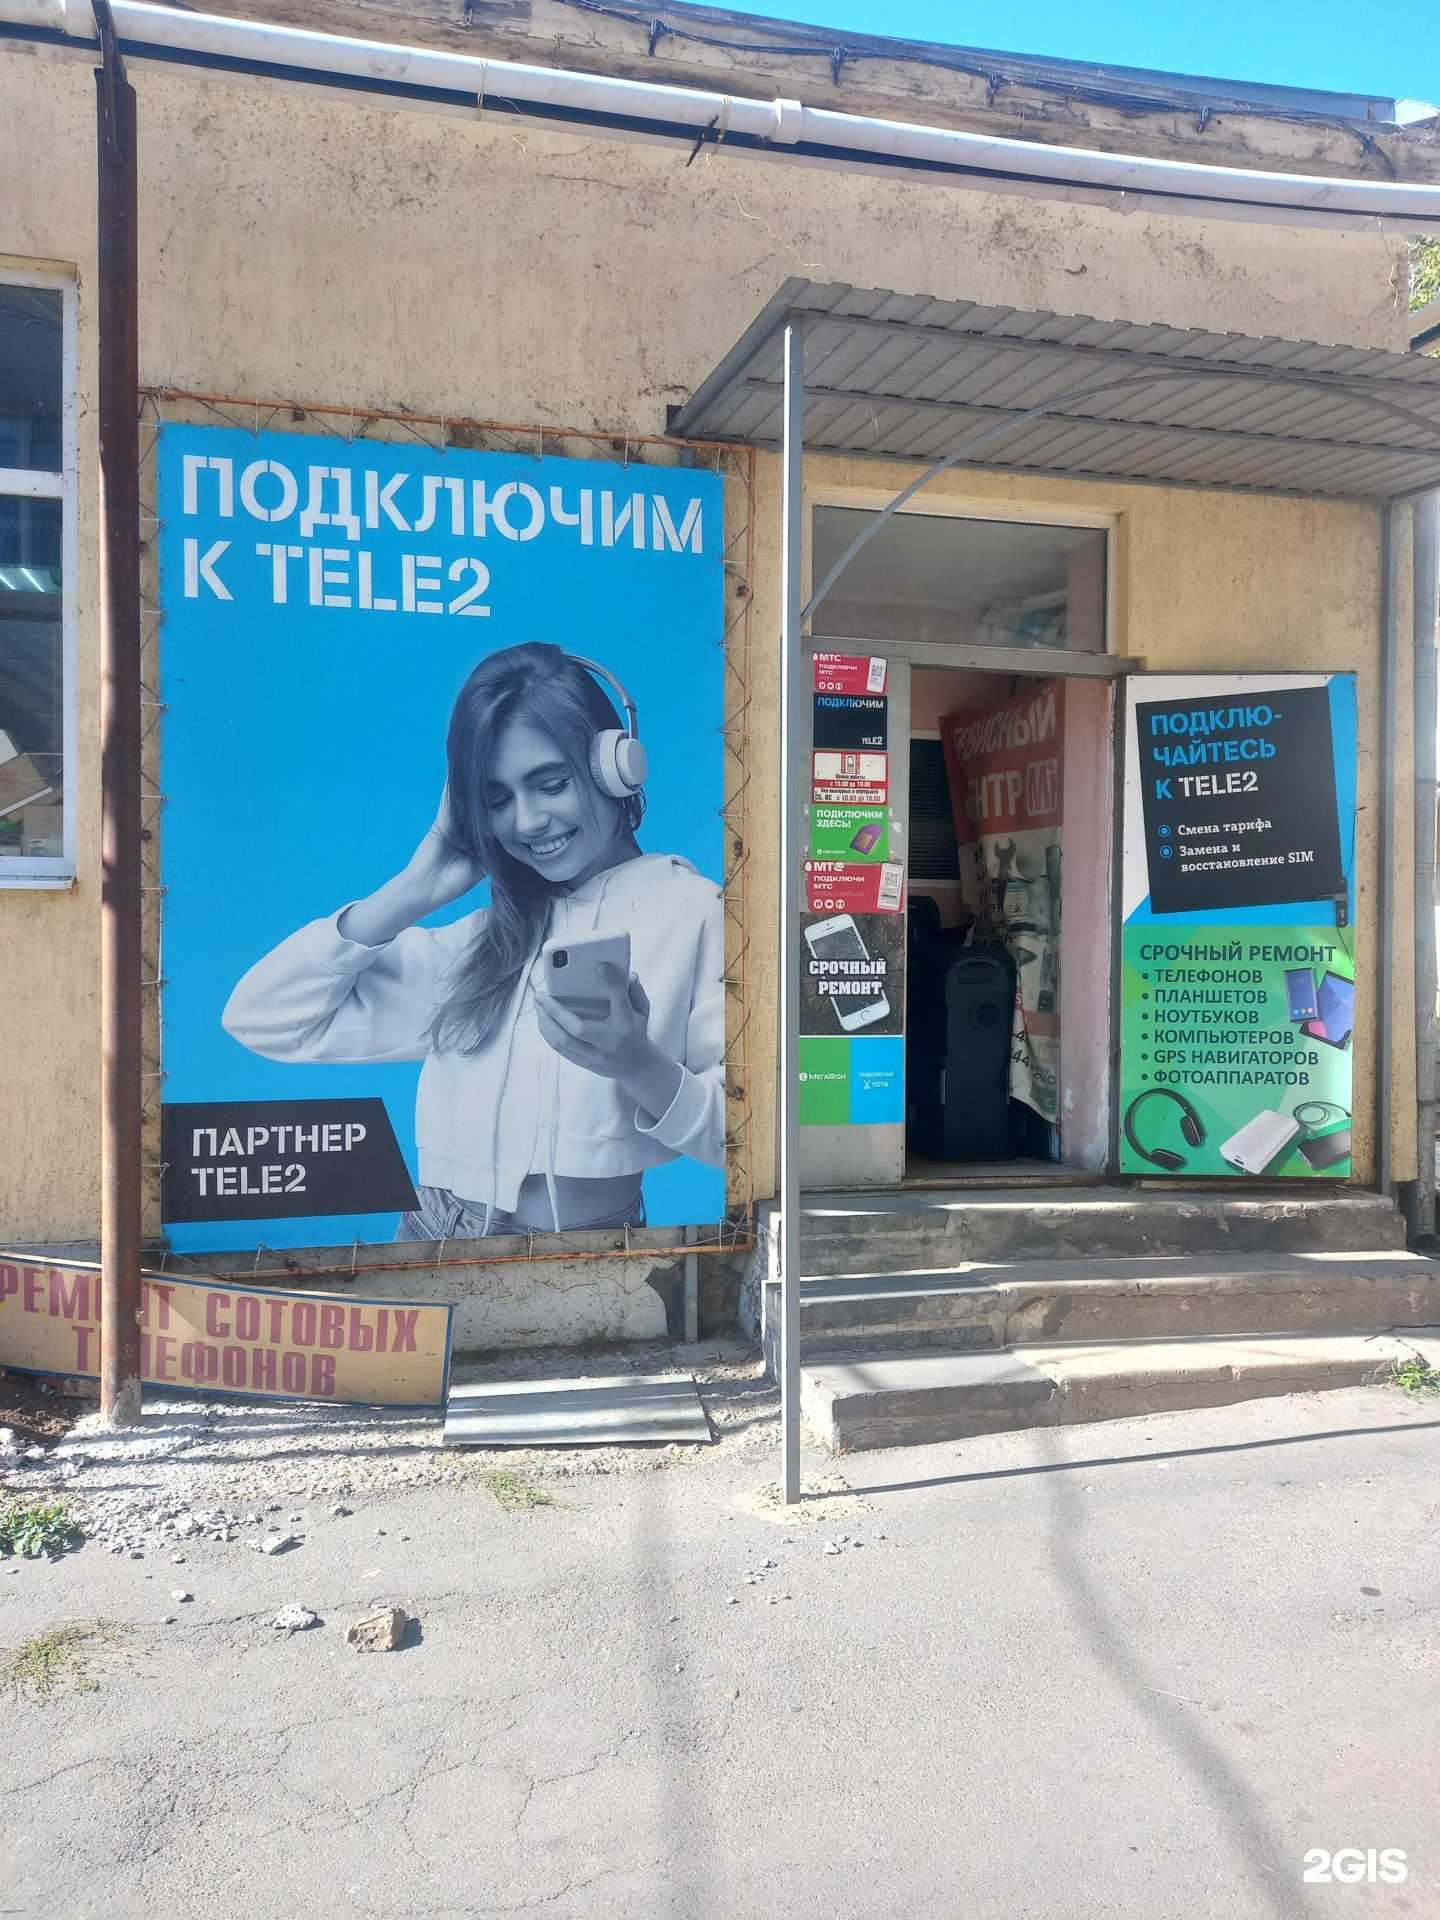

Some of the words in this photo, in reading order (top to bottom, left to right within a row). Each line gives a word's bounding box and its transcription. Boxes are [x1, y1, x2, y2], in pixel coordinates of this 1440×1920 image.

[183, 455, 702, 553] ПОДКЛЮЧИМ
[184, 538, 234, 600] К
[256, 543, 490, 617] TELE2
[820, 653, 841, 662] МТС
[817, 697, 883, 709] ПОДКЛЮЧИМ
[1151, 705, 1282, 737] ПОДКЛЮ-
[862, 736, 883, 745] TELE2
[1152, 738, 1277, 767] ЧАЙТЕСЬ
[1155, 778, 1173, 800] К
[1178, 771, 1259, 798] TELE2
[816, 809, 884, 819] ПОДКЛЮЧИМ
[1177, 824, 1220, 836] Смена
[1223, 818, 1273, 834] тарифа
[1179, 844, 1228, 857] Замена
[1232, 844, 1241, 853] и
[814, 862, 844, 871] МТС
[1181, 856, 1285, 872] восстановление
[1288, 851, 1314, 864] SIM
[1140, 940, 1242, 961] СРОЧНЫЙ
[1250, 945, 1336, 962] РЕМОНТ
[809, 958, 887, 975] СРОЧНЫЙ
[1154, 969, 1263, 984] ТЕЛЕФОНОВ
[818, 980, 882, 995] РЕМОНТ
[1154, 989, 1268, 1004] ПЛАНШЕТОВ
[1154, 1009, 1259, 1024] НОУТБУКОВ
[1154, 1029, 1294, 1045] КОМПЬЮТЕРОВ
[1153, 1050, 1186, 1064] GPS
[1191, 1050, 1319, 1065] НАВИГАТОРОВ
[1153, 1069, 1310, 1085] ФОТОАППАРАТОВ
[191, 1123, 366, 1157] ПАРТНЕР
[191, 1164, 307, 1197] TELE2
[0, 1263, 175, 1331] РЕМТ
[206, 1292, 419, 1353] СОТОВЫХ
[72, 1325, 336, 1397] ТЕФОНОВ
